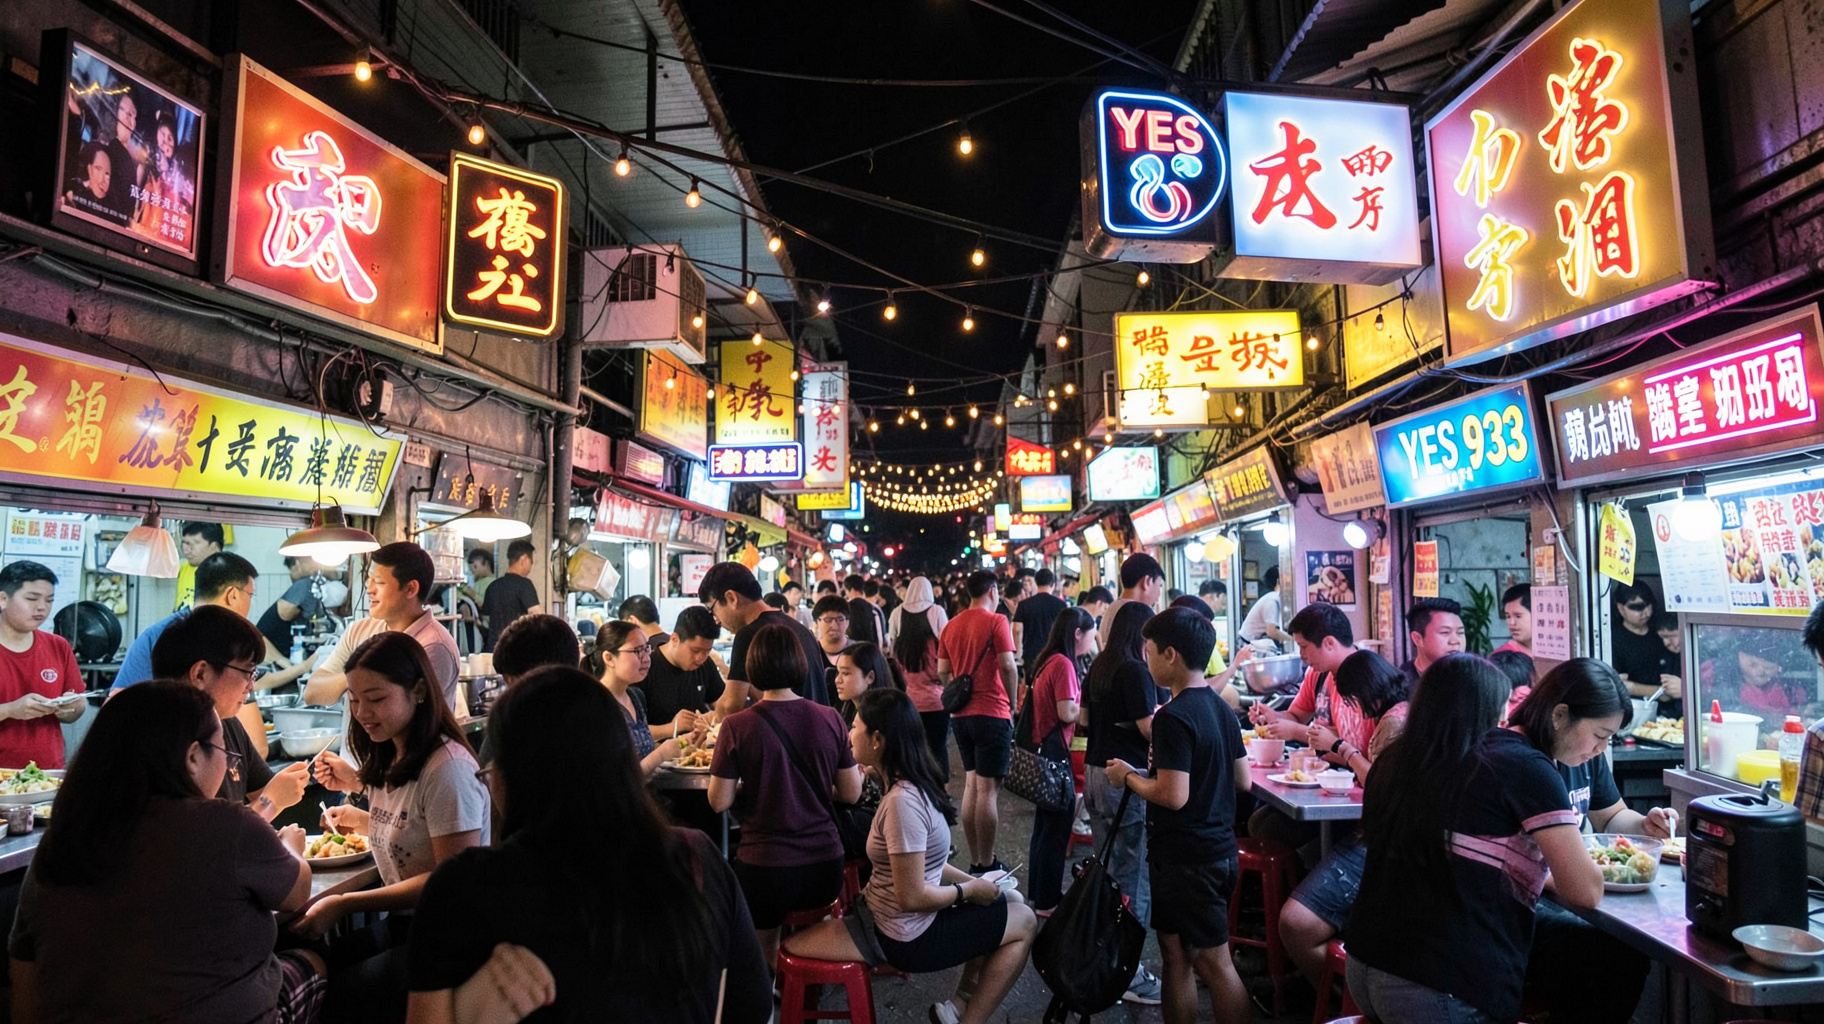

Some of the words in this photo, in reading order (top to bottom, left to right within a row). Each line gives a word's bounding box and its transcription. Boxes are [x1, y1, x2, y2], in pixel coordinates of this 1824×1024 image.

[1110, 107, 1203, 154] YES
[1398, 420, 1459, 480] YES
[1462, 404, 1528, 470] 933
